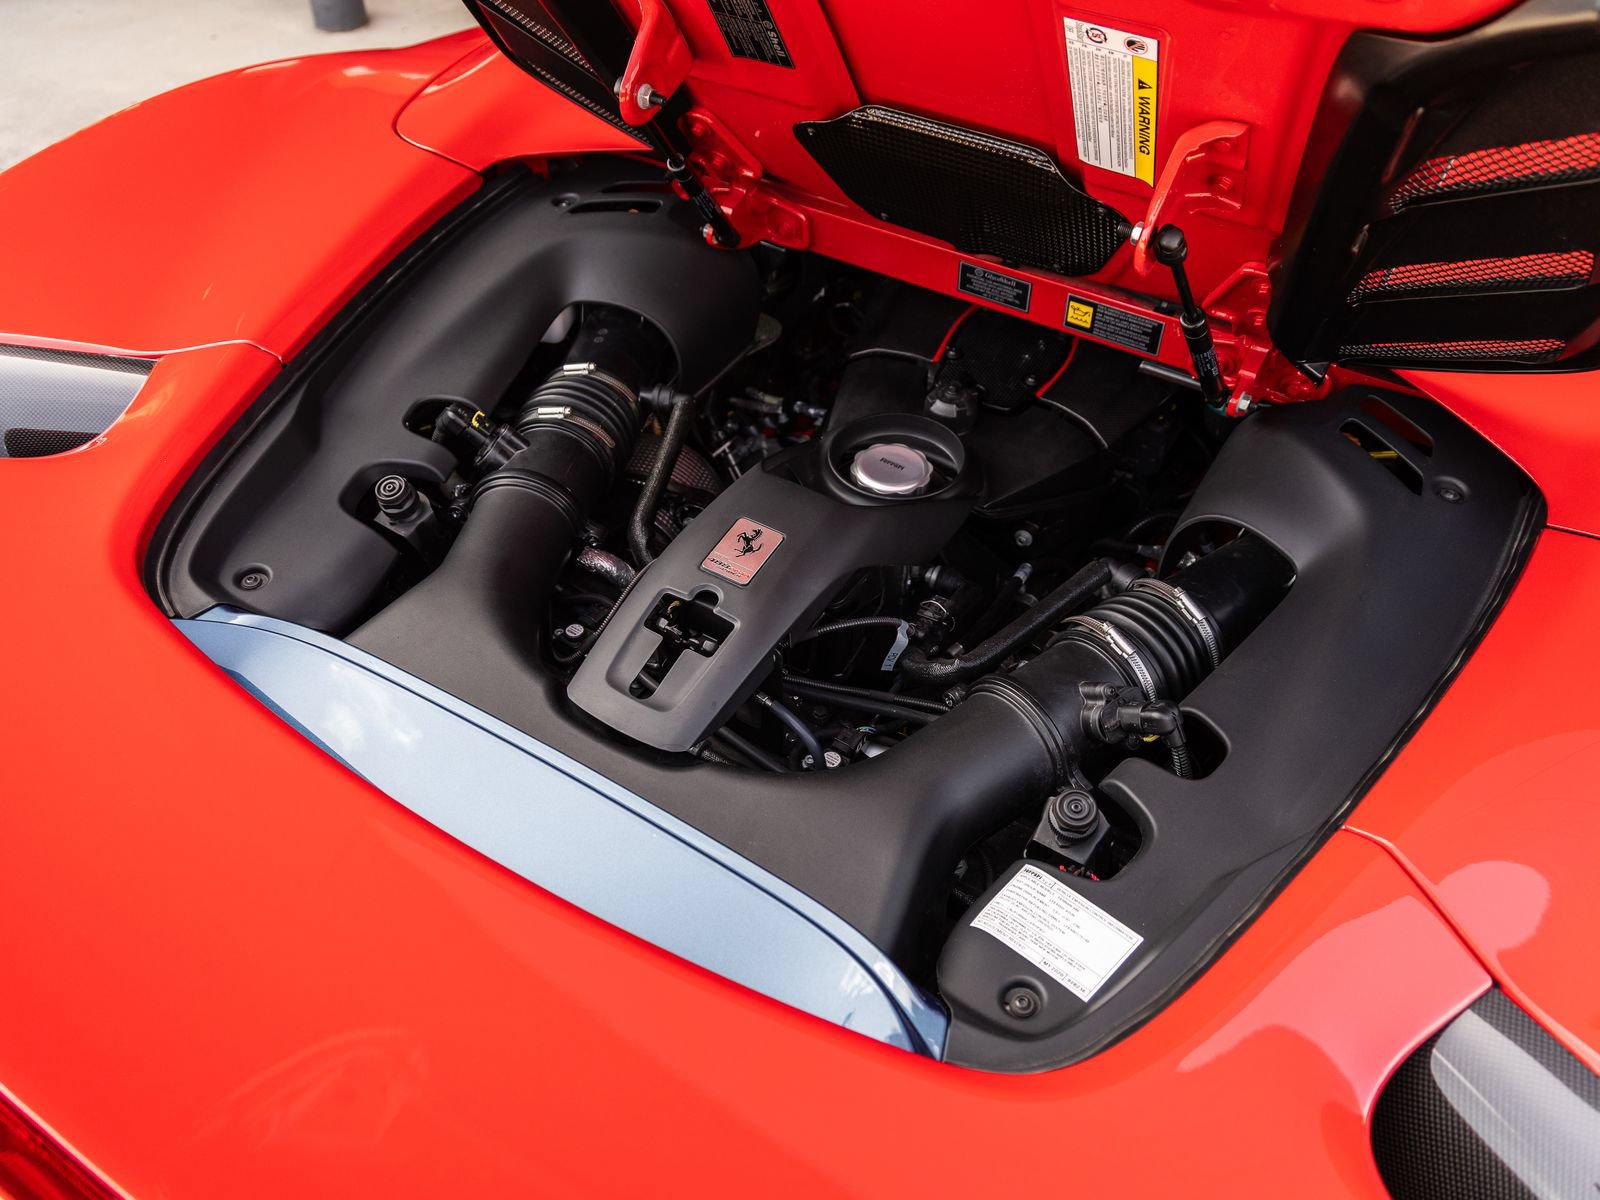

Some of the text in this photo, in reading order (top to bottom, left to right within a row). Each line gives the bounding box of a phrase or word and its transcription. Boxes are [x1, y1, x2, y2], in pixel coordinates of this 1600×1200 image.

[768, 30, 786, 58] Shell
[1138, 96, 1151, 156] WARNING
[879, 458, 906, 472] Ferrari
[1023, 868, 1042, 879] Ferrari
